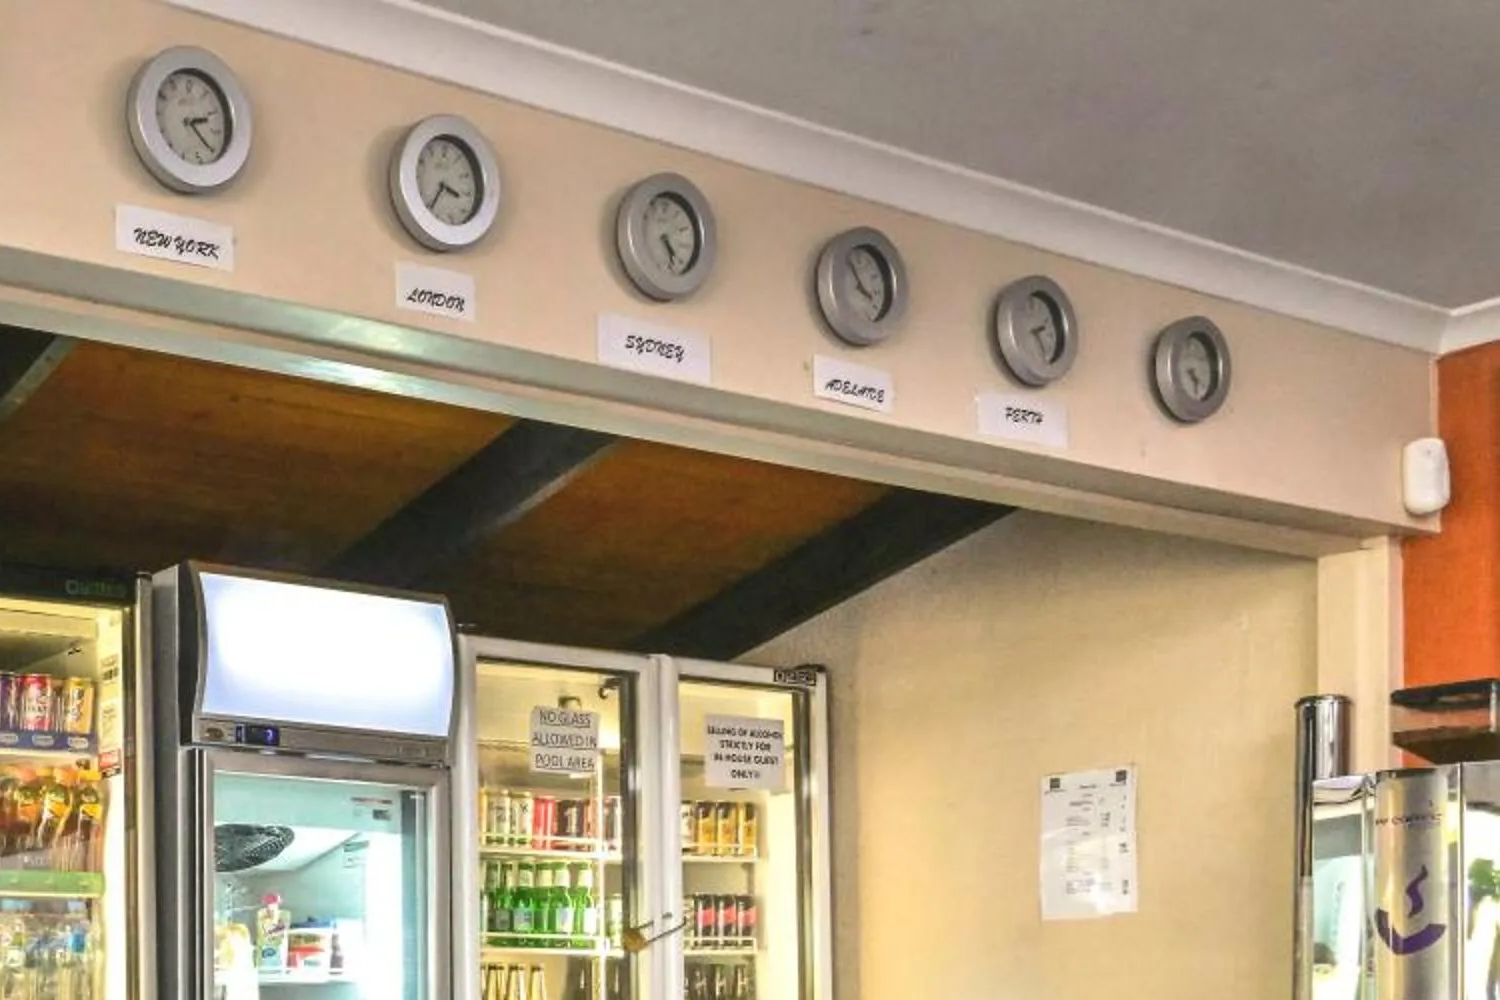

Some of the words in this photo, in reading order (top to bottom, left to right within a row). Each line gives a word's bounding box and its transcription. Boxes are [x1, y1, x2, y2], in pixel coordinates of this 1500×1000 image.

[133, 227, 172, 249] NEW
[173, 236, 220, 260] YORK
[406, 287, 465, 312] LONDON
[624, 334, 685, 363] SYDNEY
[1004, 406, 1044, 425] PERTH
[540, 710, 557, 723] NO
